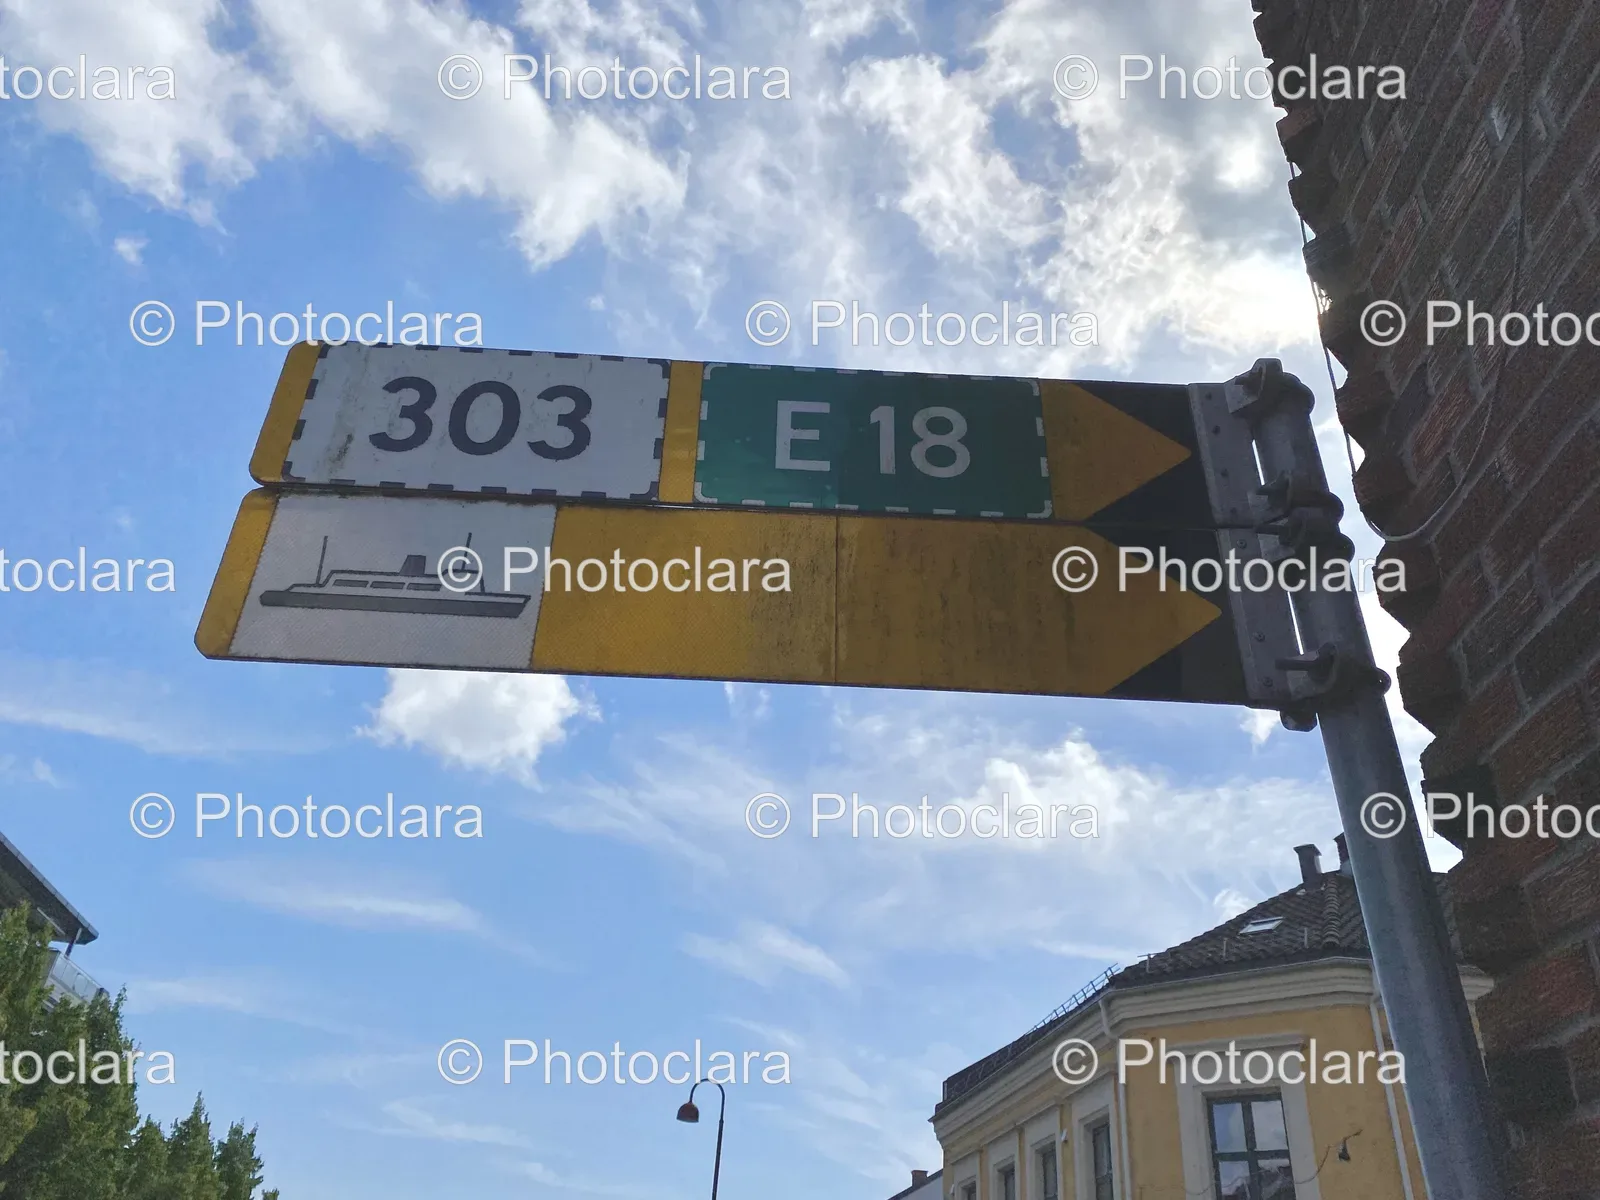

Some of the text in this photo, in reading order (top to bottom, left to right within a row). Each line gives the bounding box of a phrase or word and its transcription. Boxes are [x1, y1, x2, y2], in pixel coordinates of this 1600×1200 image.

[369, 376, 592, 461] 303
[775, 400, 971, 478] E 18
